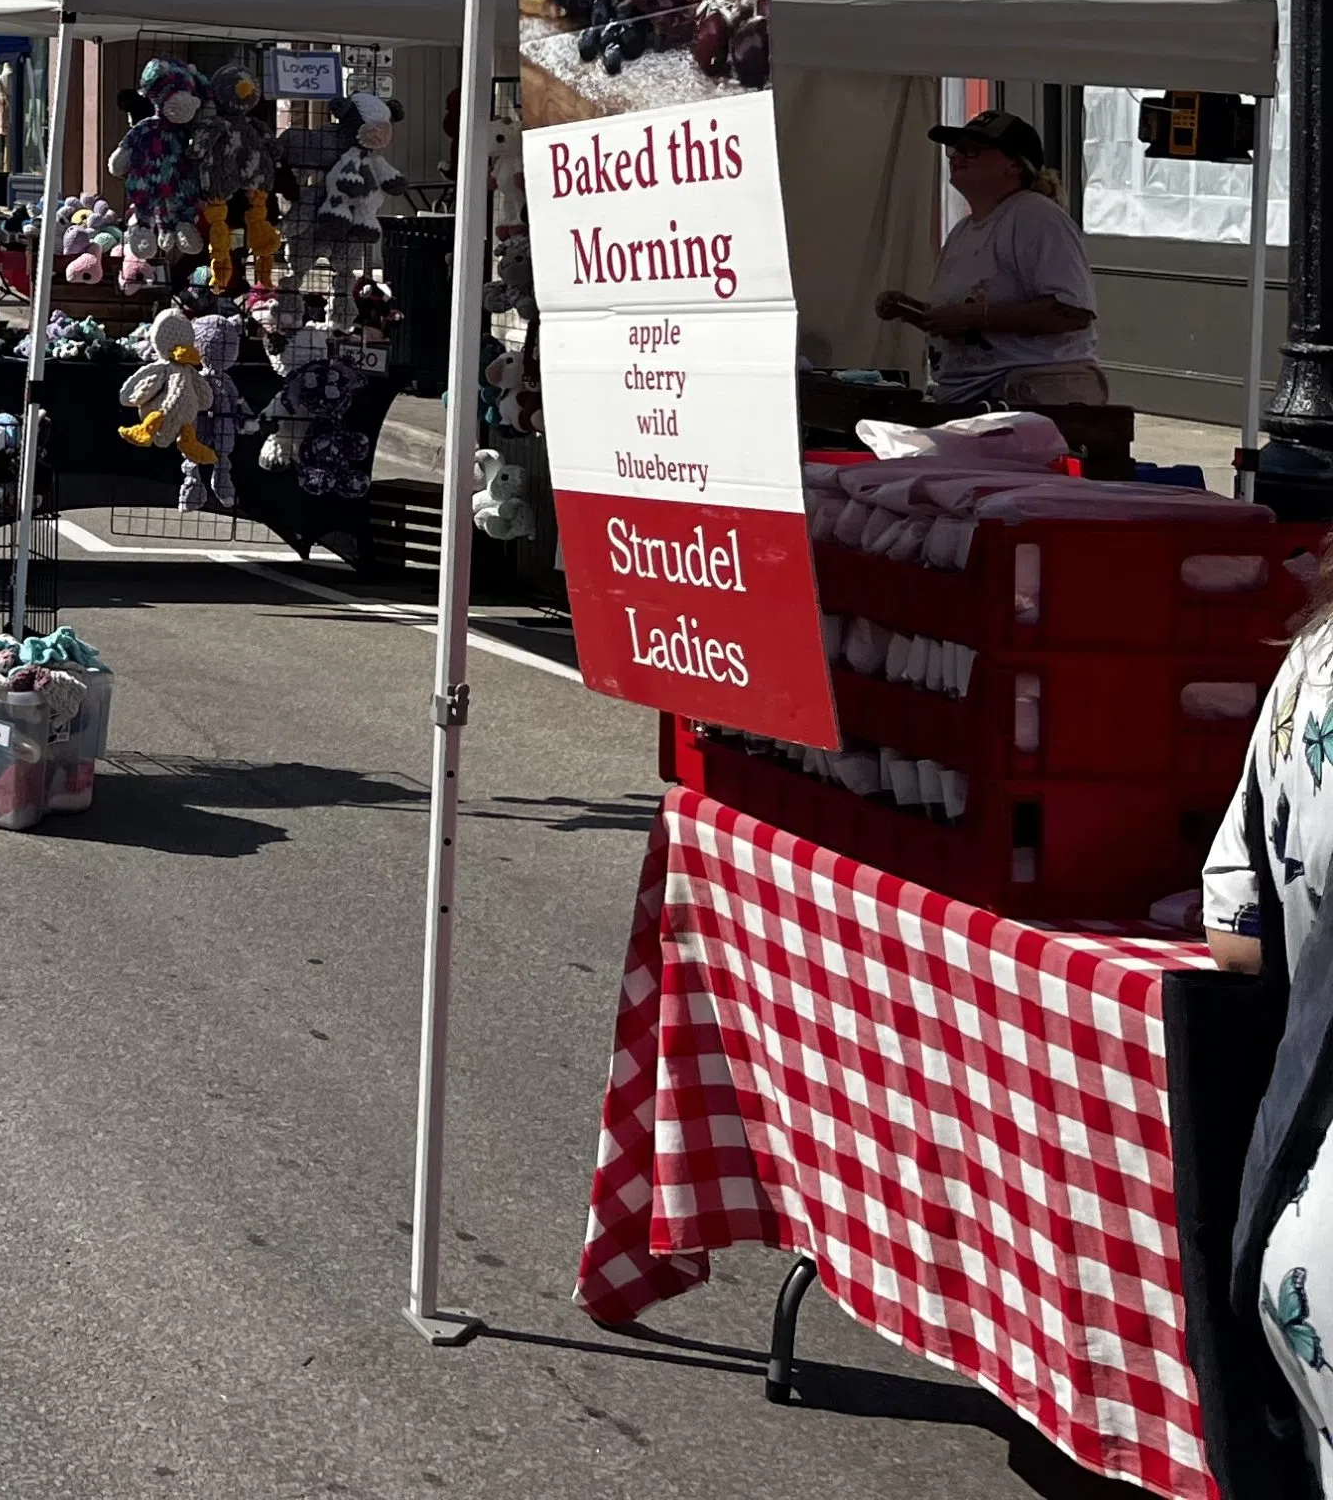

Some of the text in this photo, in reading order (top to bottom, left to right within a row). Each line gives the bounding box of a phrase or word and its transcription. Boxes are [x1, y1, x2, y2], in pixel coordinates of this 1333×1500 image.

[282, 59, 330, 77] Loveys
[293, 77, 320, 90] $45
[549, 118, 742, 198] Baked this
[570, 219, 737, 299] Morning
[628, 318, 681, 353] apple
[624, 363, 686, 399] cherry
[636, 408, 679, 437] wild
[615, 451, 709, 492] blueberry
[607, 516, 747, 592] Strudel
[625, 606, 749, 687] Ladies
